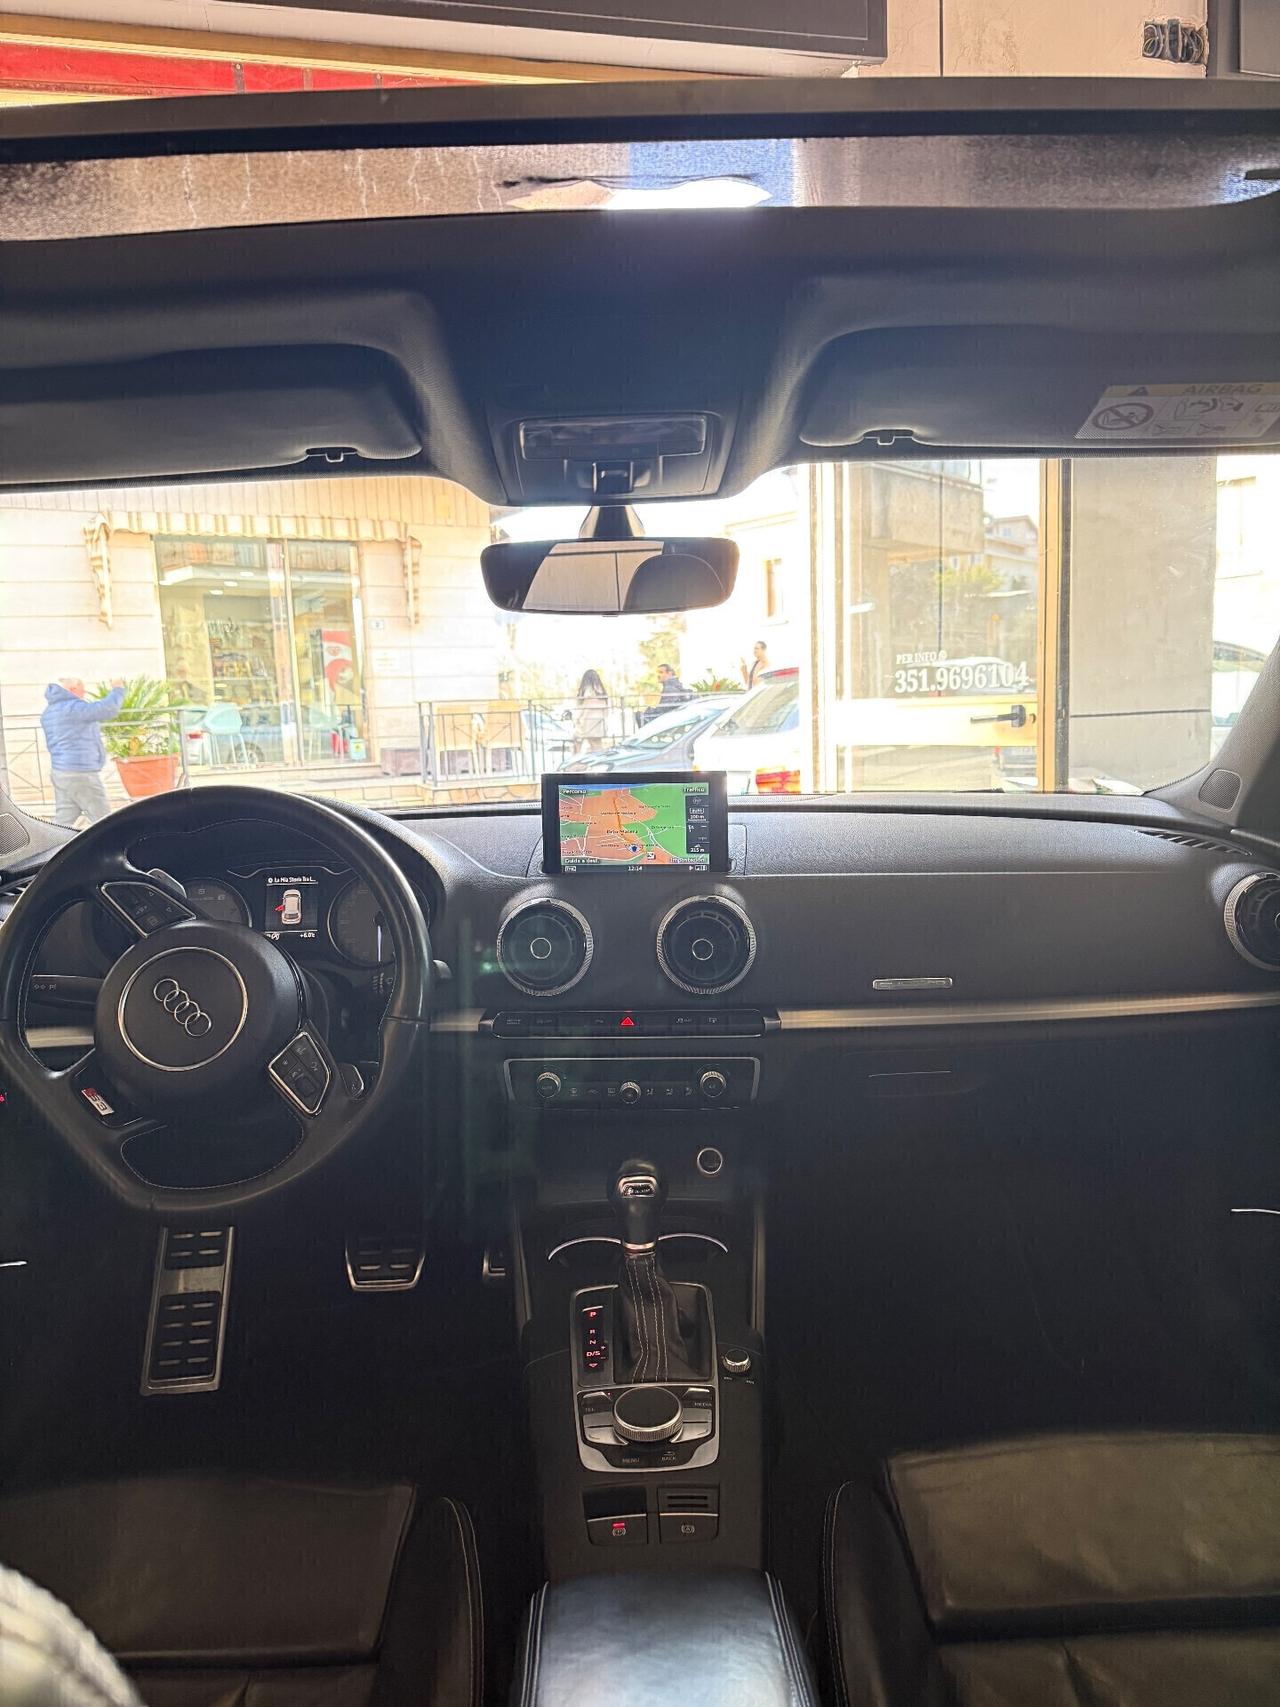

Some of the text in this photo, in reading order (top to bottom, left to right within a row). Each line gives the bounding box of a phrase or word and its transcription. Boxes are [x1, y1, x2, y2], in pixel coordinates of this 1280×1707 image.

[1180, 384, 1264, 395] AIRBAG
[896, 651, 937, 665] PER INFO
[894, 661, 1030, 694] 351.9696104
